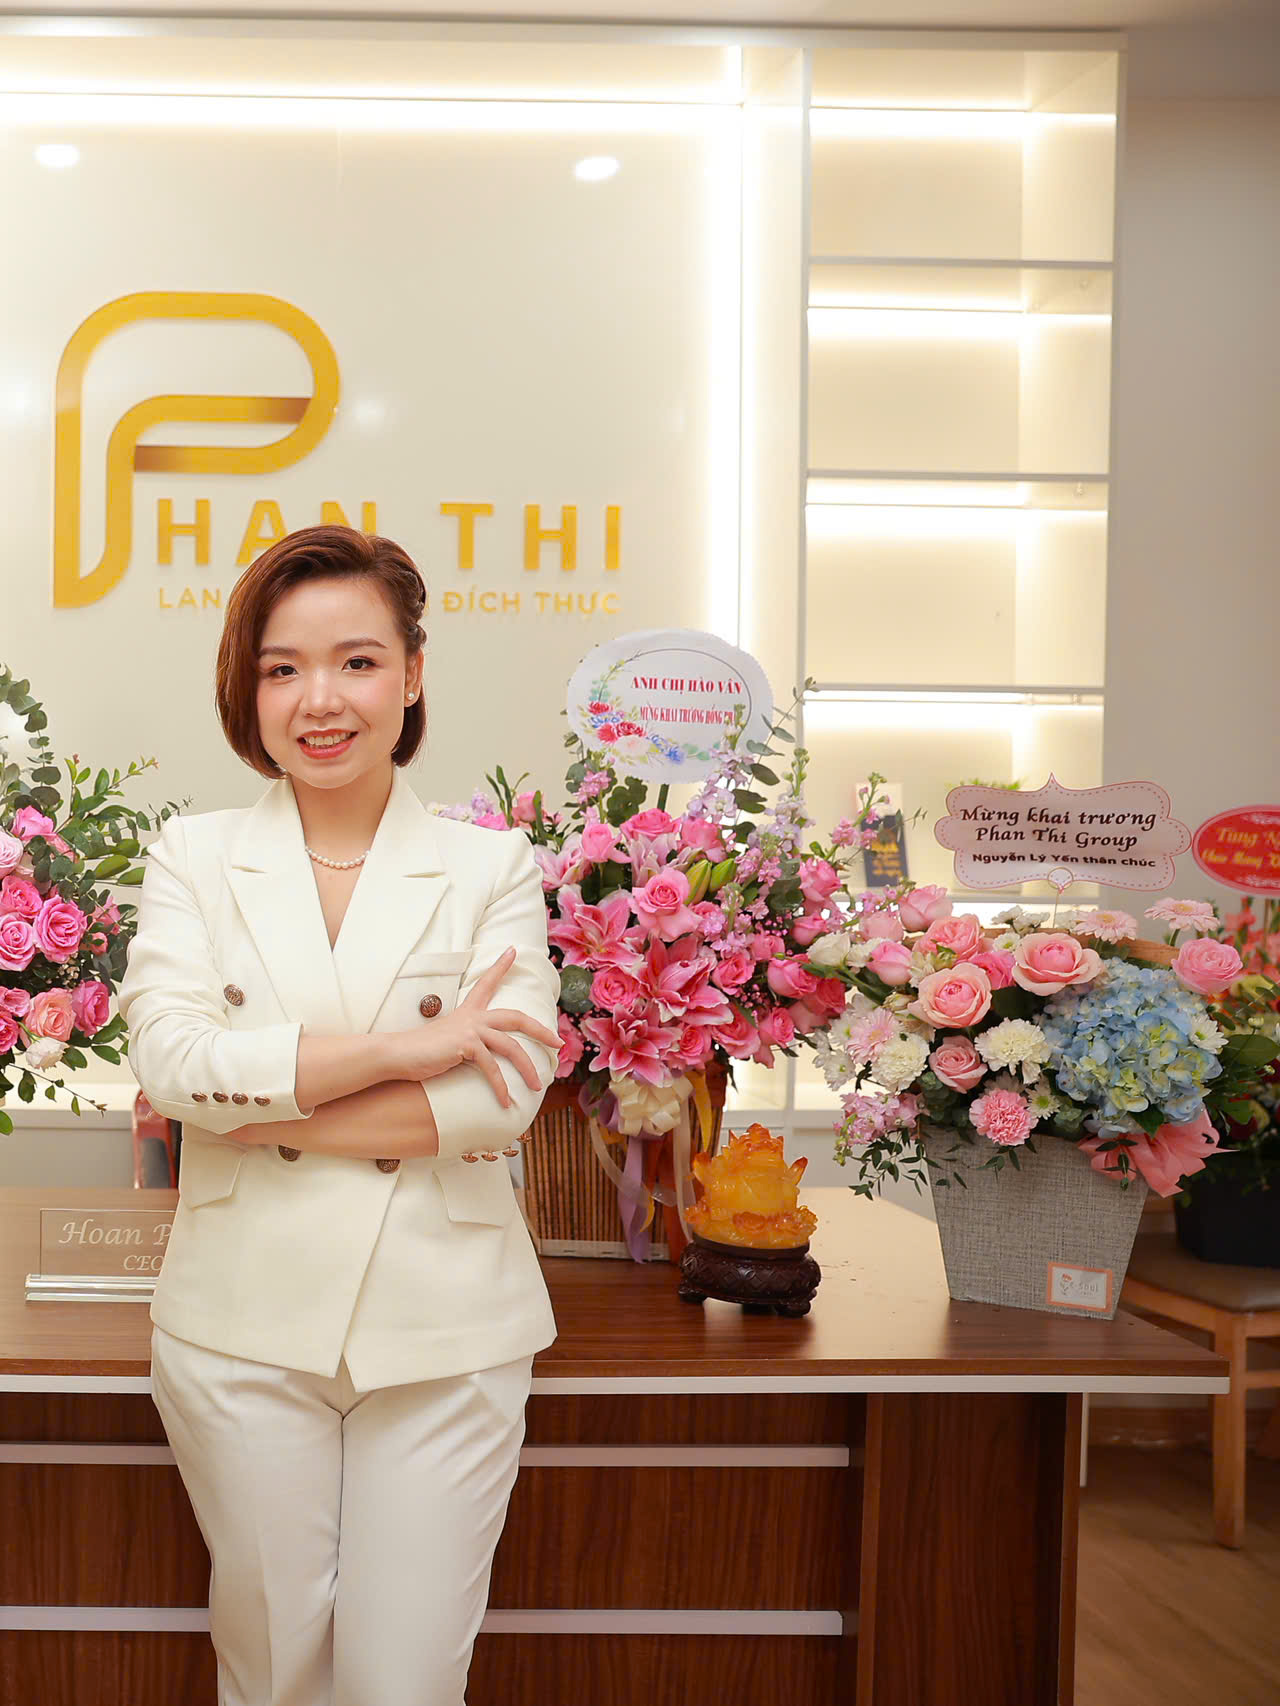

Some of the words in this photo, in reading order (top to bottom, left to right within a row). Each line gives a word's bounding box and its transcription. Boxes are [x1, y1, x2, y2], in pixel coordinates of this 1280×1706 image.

[439, 502, 621, 572] THI
[159, 587, 222, 609] LAN
[442, 584, 521, 613] ĐÍCH
[534, 589, 620, 620] THỰC
[632, 676, 659, 690] ANH
[662, 677, 685, 695] CHỊ
[688, 676, 715, 693] HÀO
[660, 706, 678, 722] KHAI
[960, 805, 1020, 826] Mừng
[1027, 807, 1071, 825] khai
[1079, 811, 1157, 831] trương
[975, 825, 1026, 841] Phan
[1032, 828, 1067, 843] Thi
[1075, 832, 1138, 852] Group
[973, 852, 1026, 864] Nguyễn
[1030, 853, 1046, 863] Lý
[1083, 856, 1117, 865] thân
[1121, 858, 1157, 867] chúc
[58, 1218, 144, 1245] Hoan
